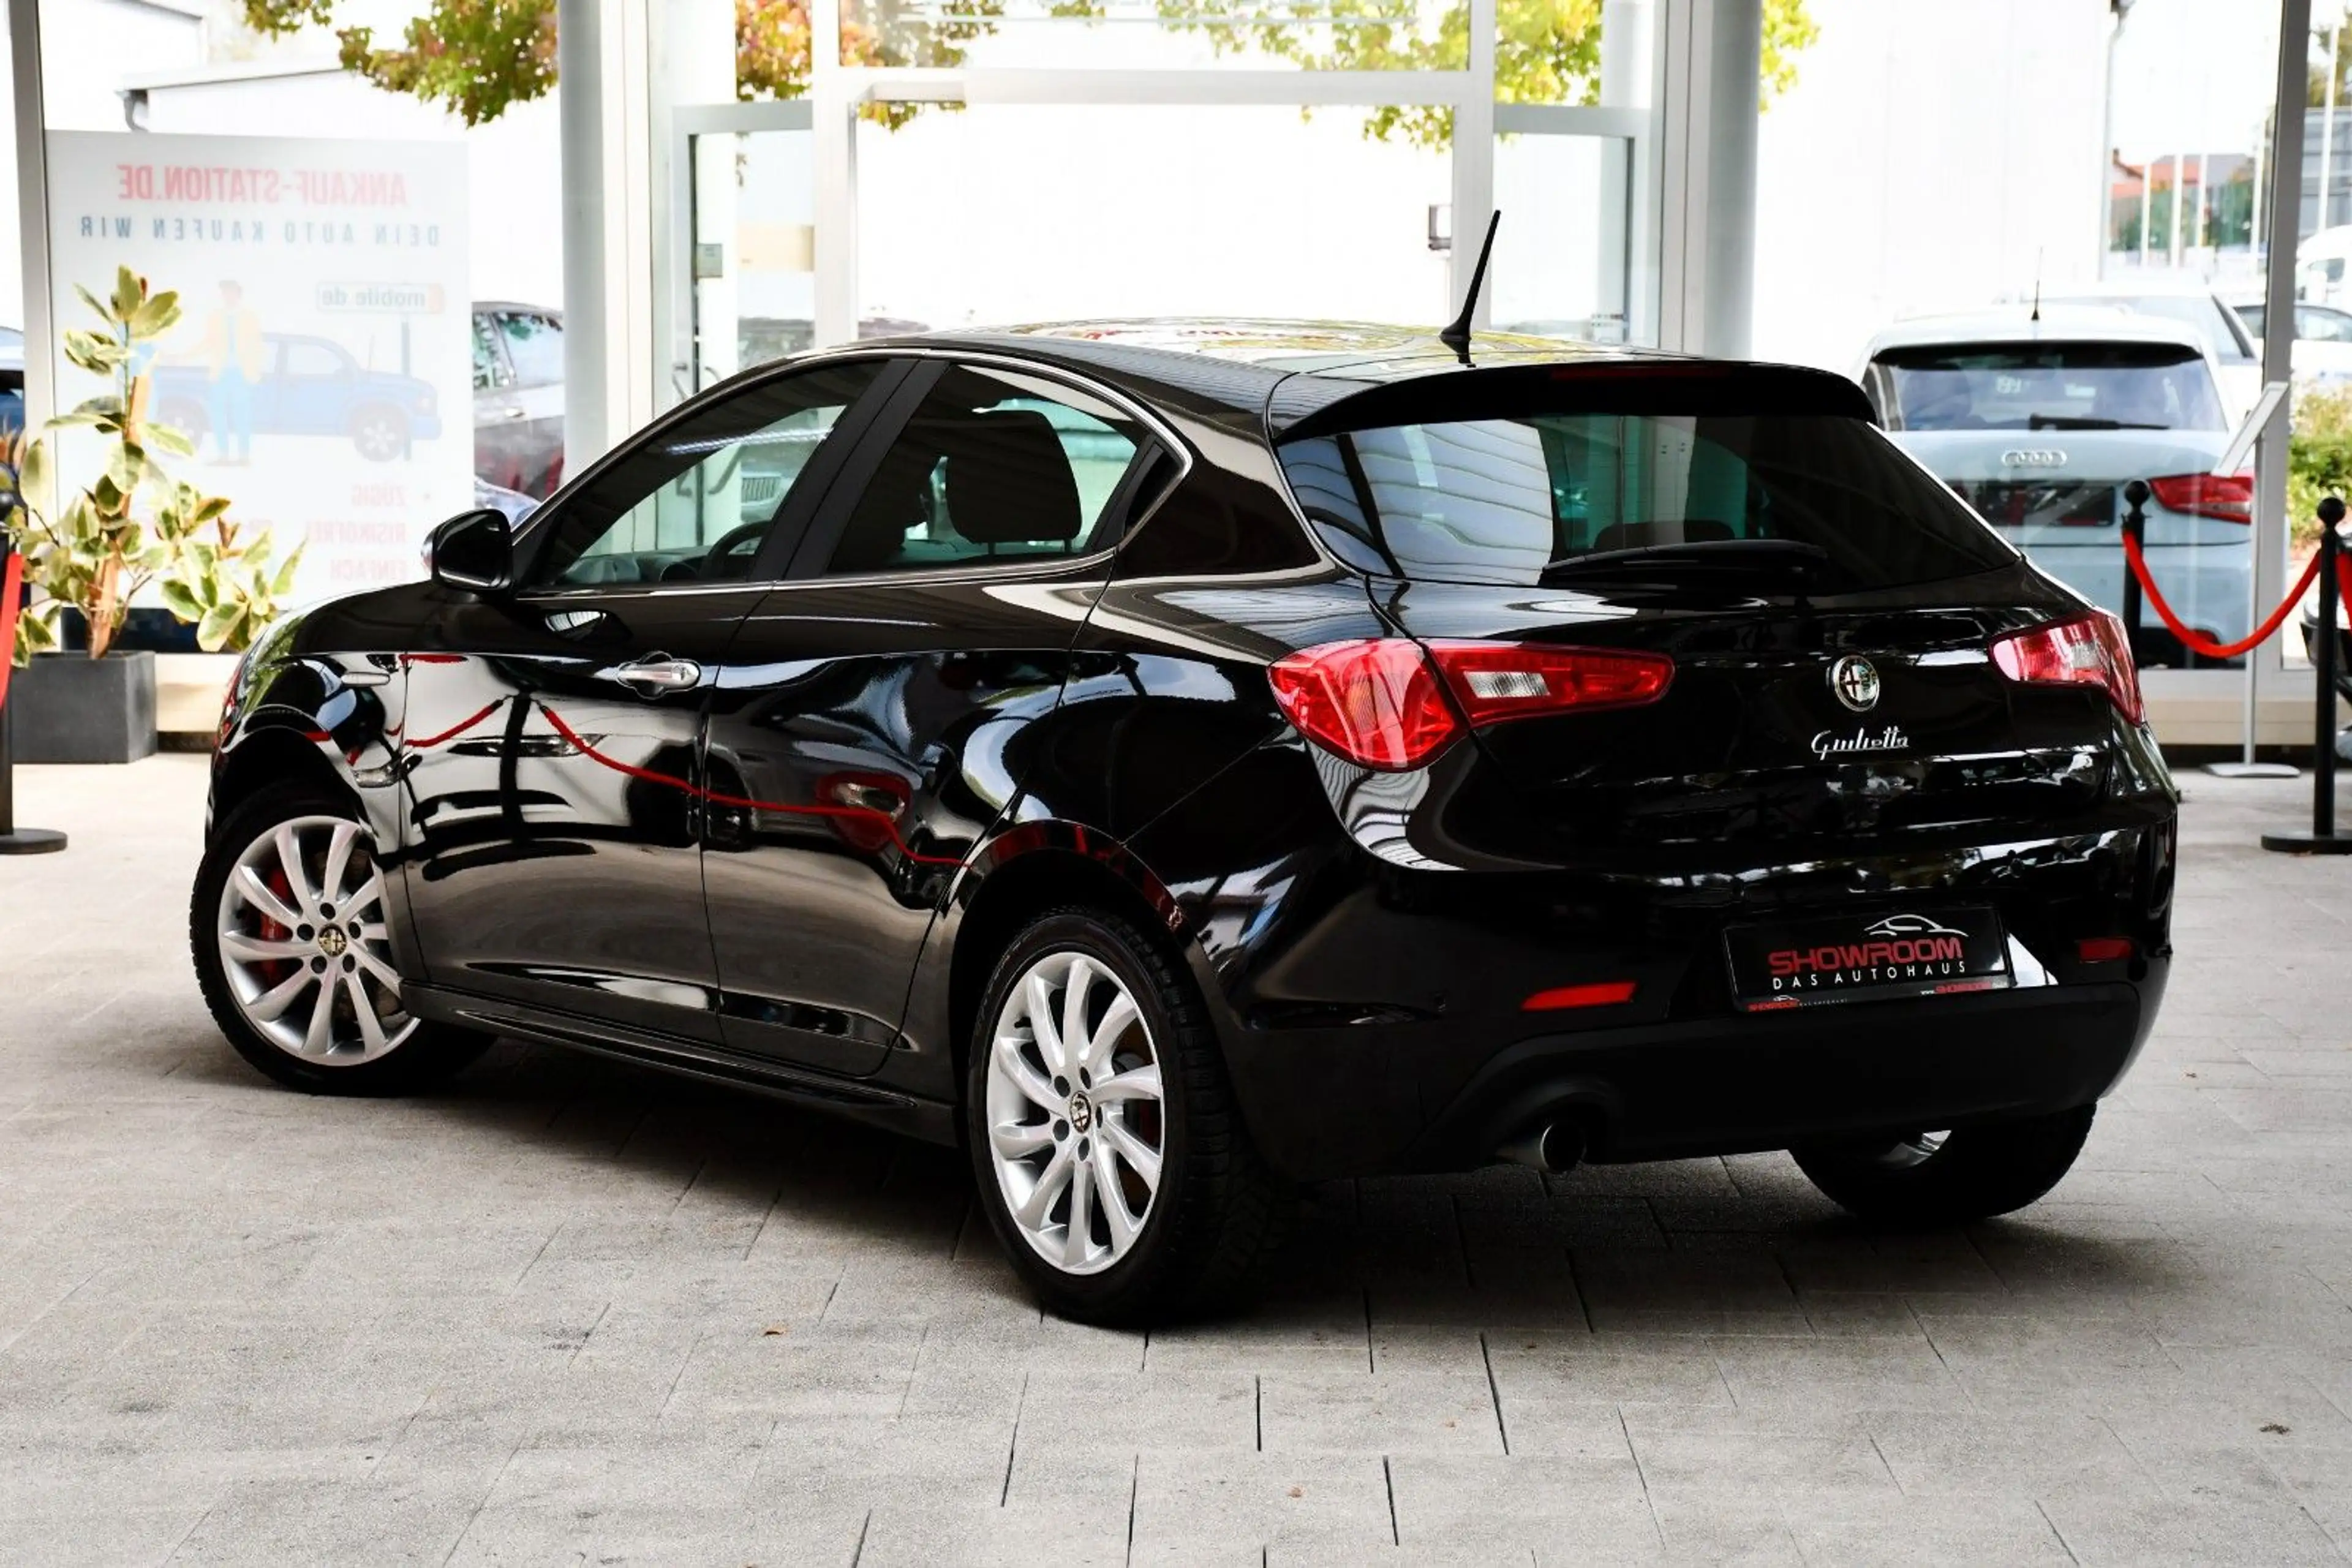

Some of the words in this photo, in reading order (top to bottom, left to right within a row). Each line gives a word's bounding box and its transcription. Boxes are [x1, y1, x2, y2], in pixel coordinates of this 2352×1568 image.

[1811, 725, 1909, 761] Giulietta
[1768, 937, 1963, 975] SHOWROOM
[1773, 974, 1819, 990] DAS
[1834, 960, 1966, 984] AUTOHAUS
